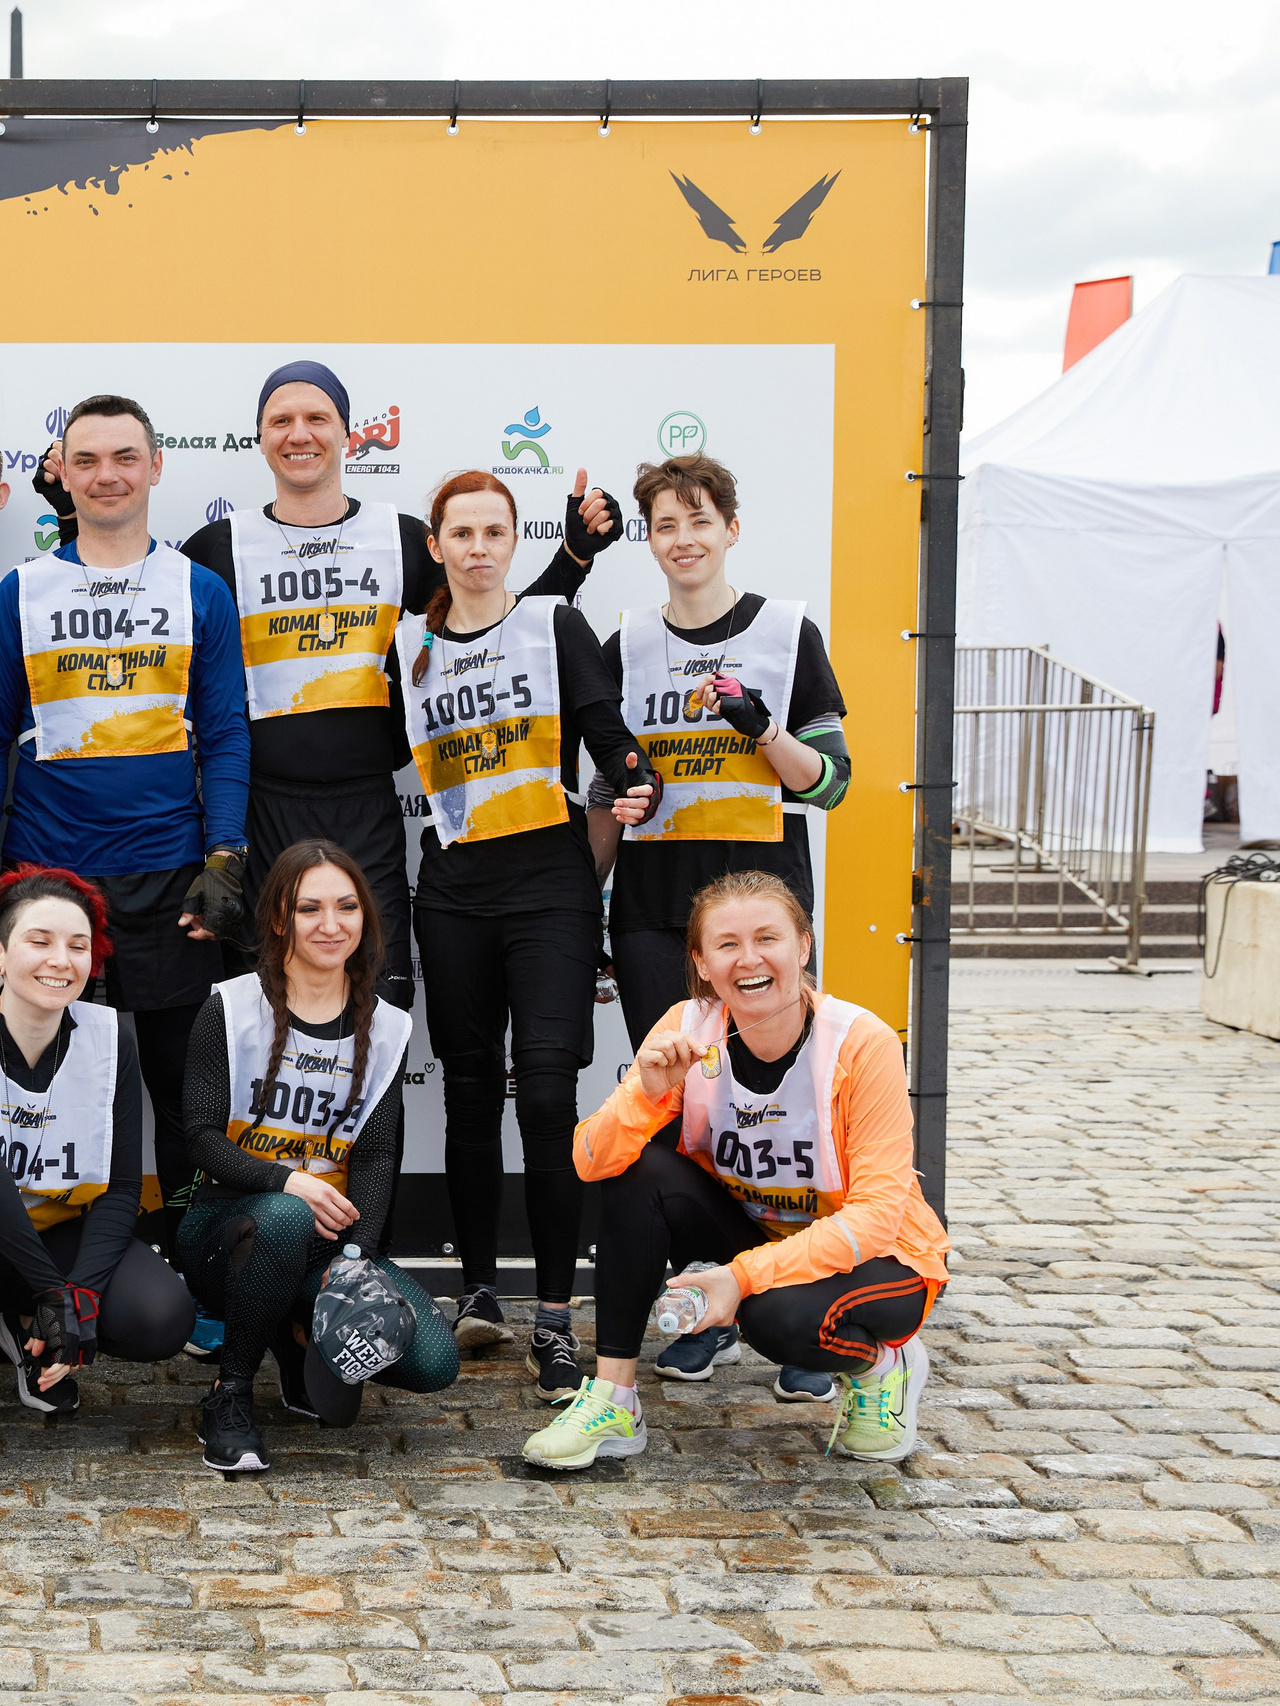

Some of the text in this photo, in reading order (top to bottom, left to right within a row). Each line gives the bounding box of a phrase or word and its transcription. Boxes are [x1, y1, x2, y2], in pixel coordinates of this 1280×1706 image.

[687, 269, 822, 281] ЛИГА ГЕРОЕВ
[353, 413, 387, 428] АДИО
[346, 465, 399, 473] ENERGY 104.2
[524, 521, 565, 540] KUDA
[299, 538, 337, 559] URBAN
[89, 578, 129, 598] URBAN
[260, 567, 380, 605] 1005-4
[50, 607, 170, 642] 1004-2
[453, 648, 488, 676] URBAN
[683, 655, 725, 677] URBAN
[421, 673, 532, 732] 1005-5
[437, 717, 530, 762] КОМАННЫЙ
[673, 757, 726, 777] СТАРТ
[295, 1053, 338, 1075] URBAN
[11, 1106, 46, 1128] URBAN
[714, 1130, 814, 1180] 003-5
